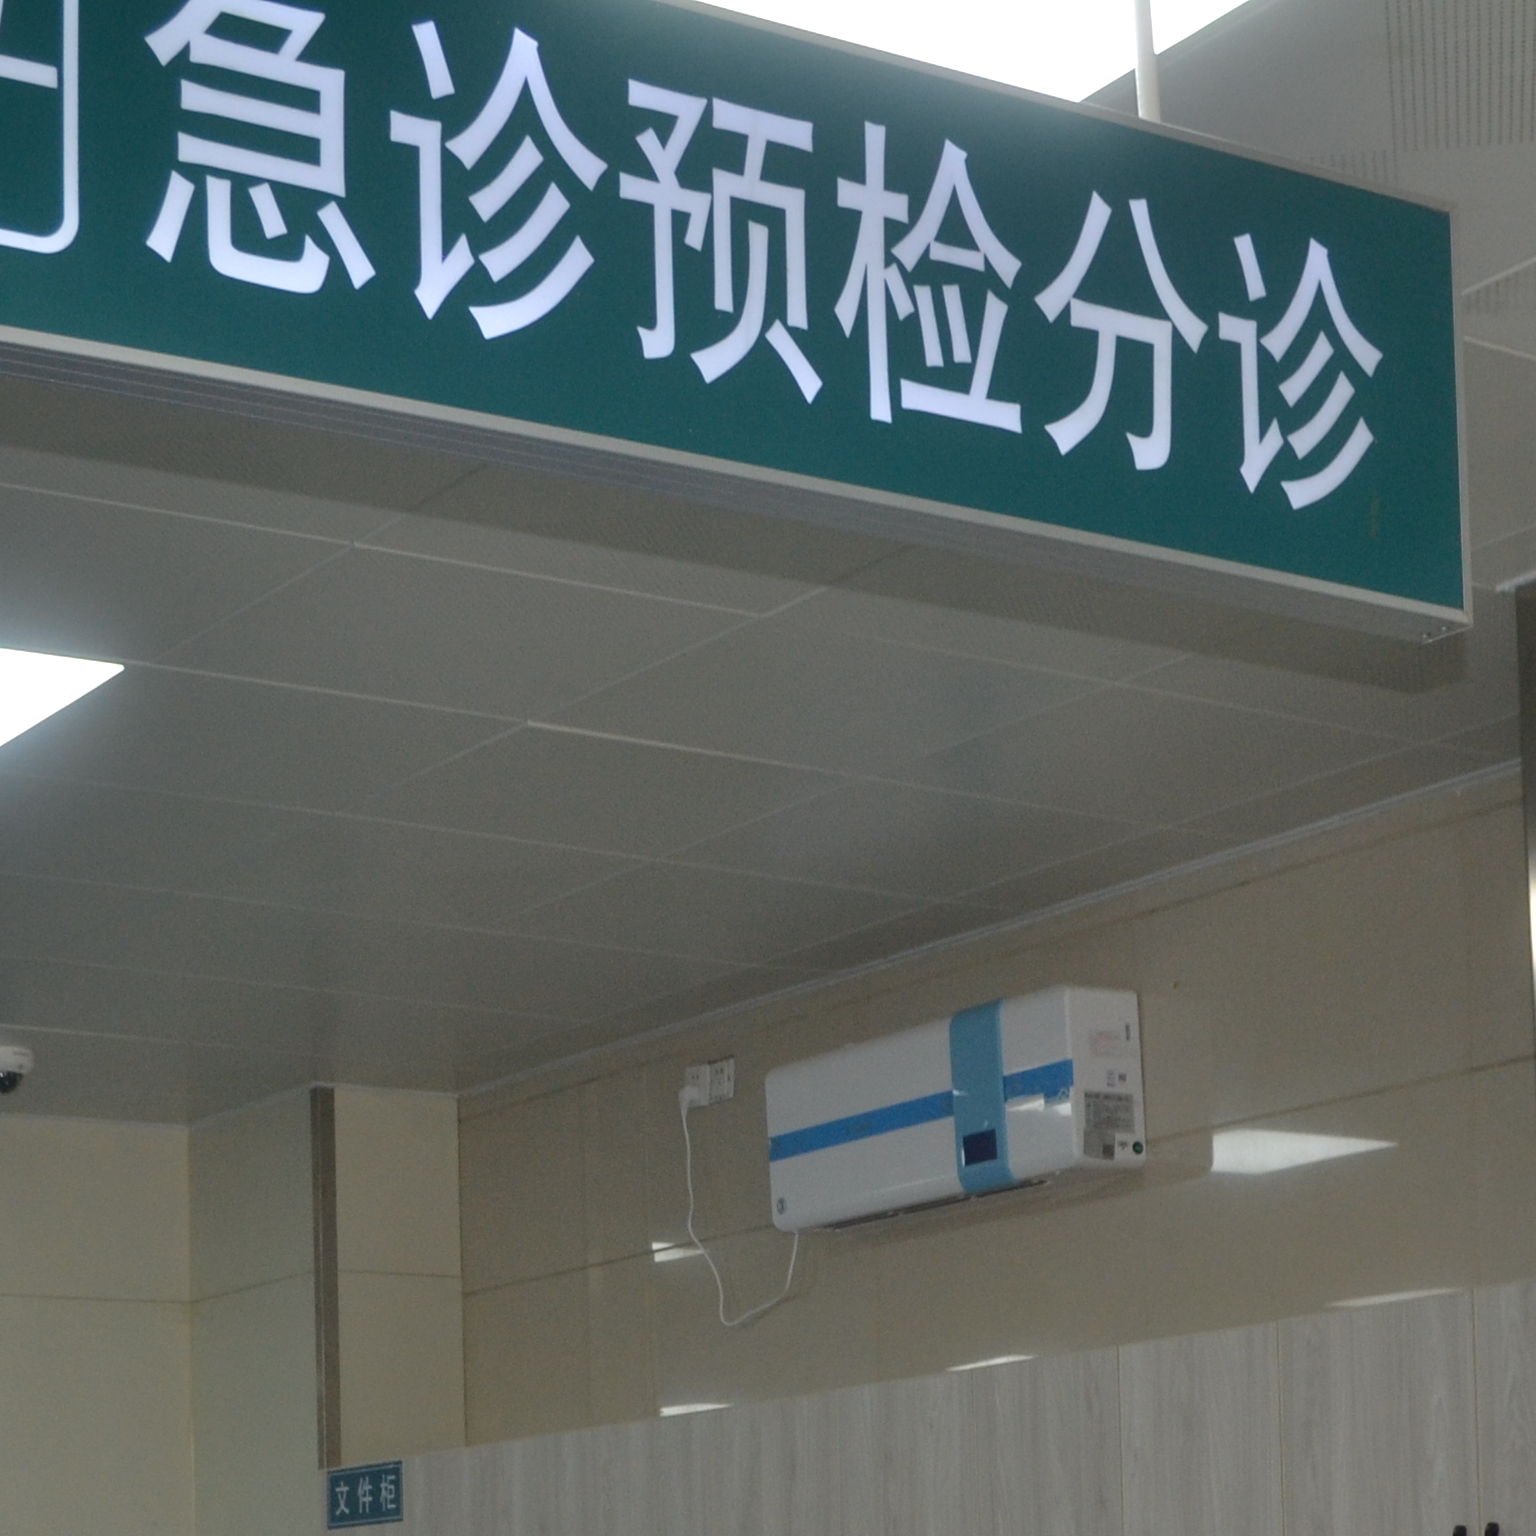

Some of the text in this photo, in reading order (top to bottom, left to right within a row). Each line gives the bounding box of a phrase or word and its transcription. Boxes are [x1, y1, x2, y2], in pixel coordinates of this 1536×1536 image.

[144, 0, 1384, 511] 急诊预检分诊
[335, 1474, 397, 1516] 文件柜
